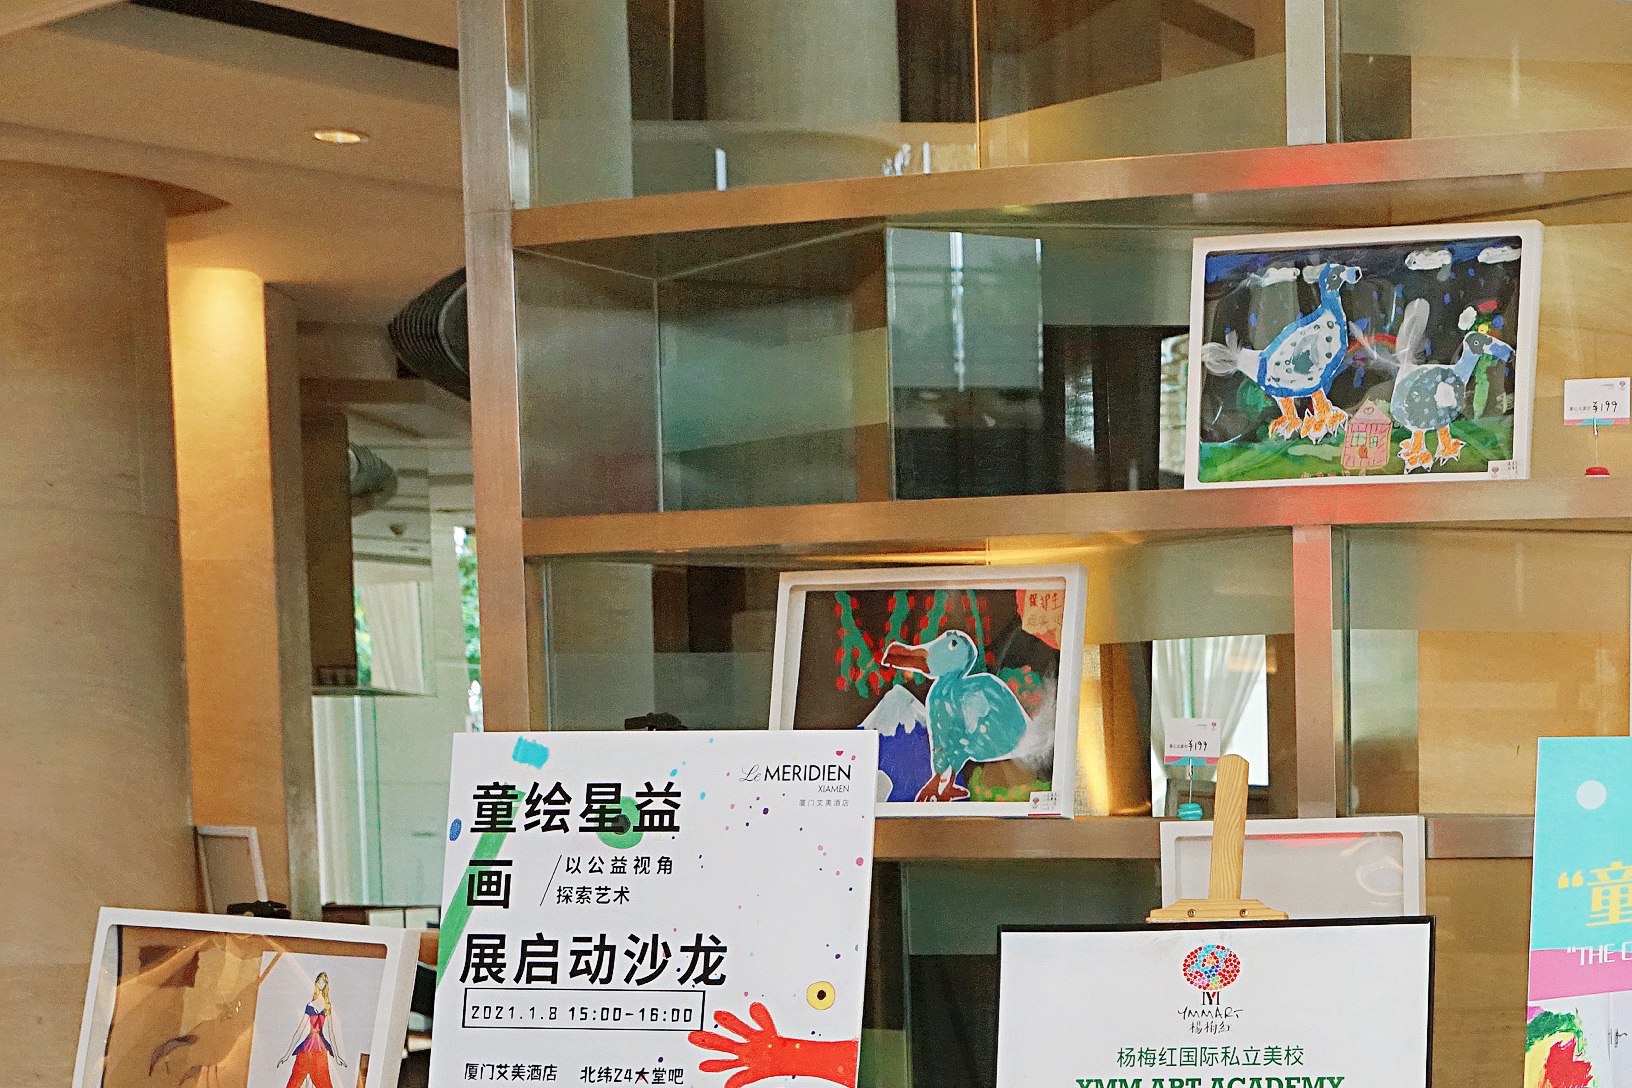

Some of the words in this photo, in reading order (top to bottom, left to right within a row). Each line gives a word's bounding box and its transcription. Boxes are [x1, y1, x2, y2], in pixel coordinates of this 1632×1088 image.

[739, 764, 762, 784] Le
[764, 764, 852, 782] MERIDIEN
[817, 785, 850, 793] XIAMEN
[470, 780, 682, 835] 童绘星益
[798, 799, 850, 807] 厦门艾美酒店
[565, 855, 673, 875] 以公益视角
[466, 859, 511, 909] 画
[555, 886, 630, 905] 探索艺术
[459, 932, 728, 987] 展启动沙龙
[471, 1005, 558, 1021] 2021.1.8
[568, 1006, 693, 1023] 15:00-16:00
[1117, 1045, 1304, 1068] 杨梅红国际私立美校
[463, 1062, 558, 1082] 厦门艾美酒店
[580, 1065, 684, 1086] 北纬24大堂吧
